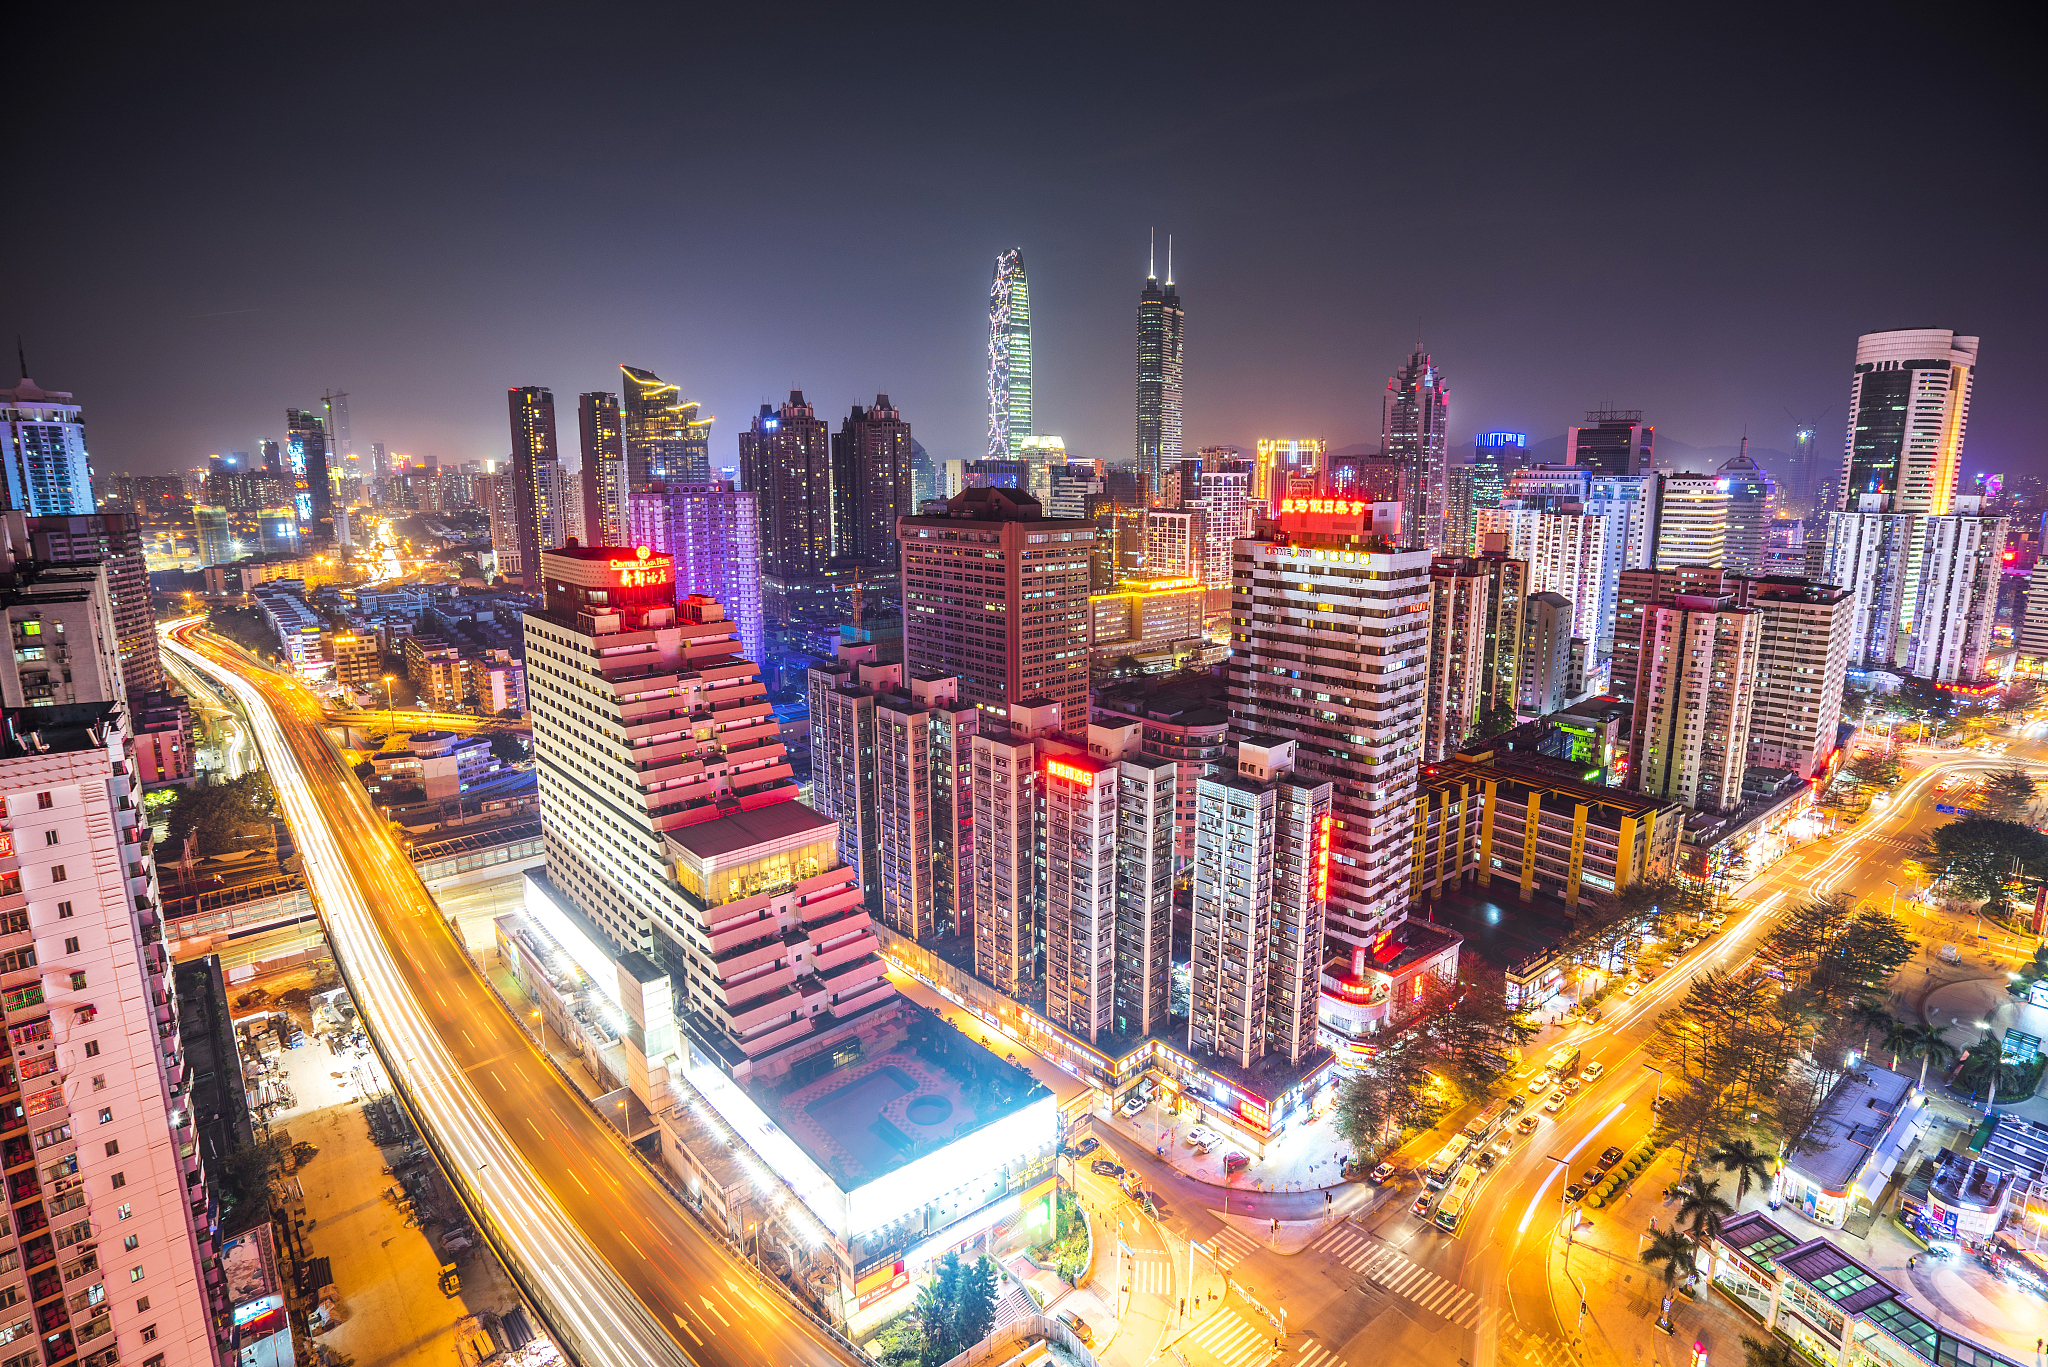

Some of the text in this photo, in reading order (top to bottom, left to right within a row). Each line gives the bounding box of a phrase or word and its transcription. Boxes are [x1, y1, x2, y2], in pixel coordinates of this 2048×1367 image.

[1265, 547, 1292, 556] HOME
[621, 569, 666, 587] 新都酒店
[1048, 760, 1093, 786] 维雅丽酒店
